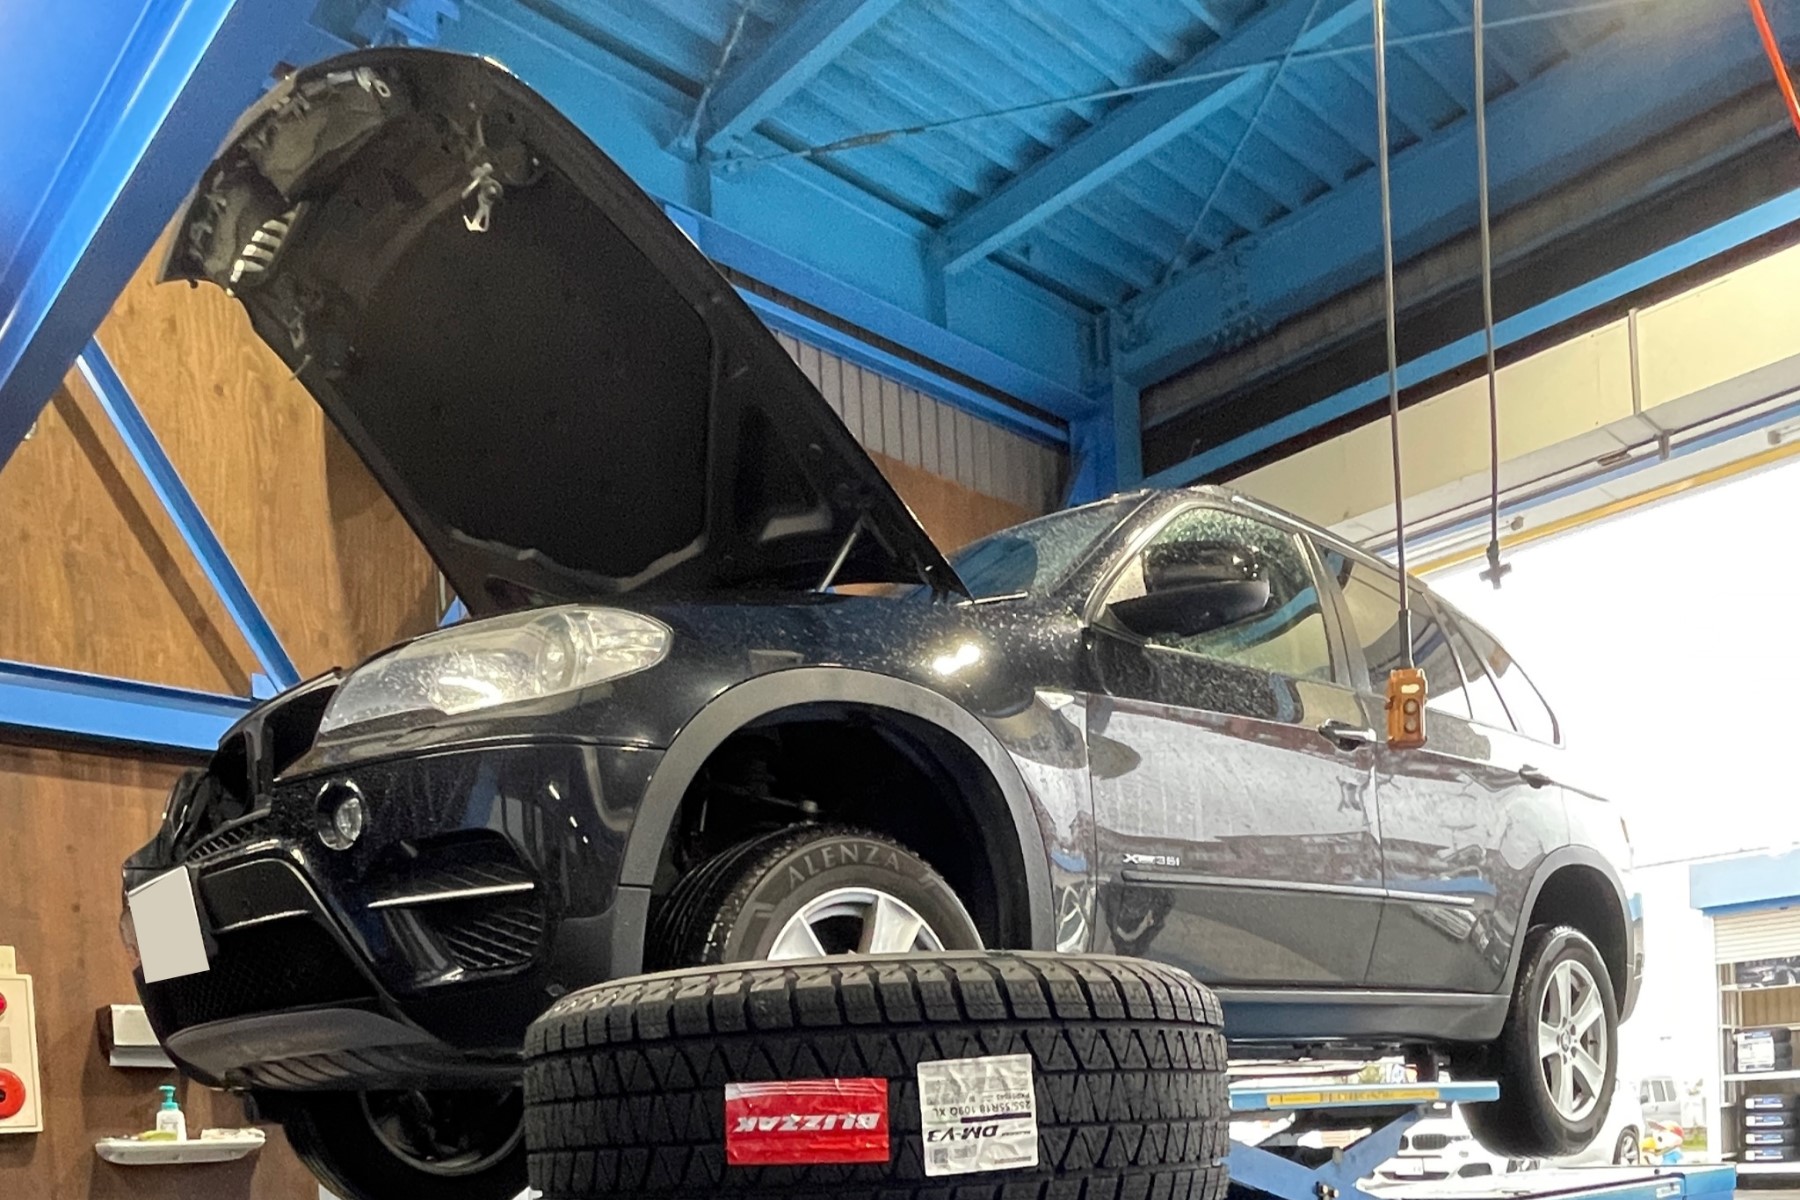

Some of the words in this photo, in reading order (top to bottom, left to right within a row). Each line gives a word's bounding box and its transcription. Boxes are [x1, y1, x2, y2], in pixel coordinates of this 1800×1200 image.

[789, 843, 901, 890] ALENZA
[932, 1107, 946, 1116] XL
[732, 1112, 880, 1133] BLIZZAK
[927, 1124, 999, 1142] DM-V3
